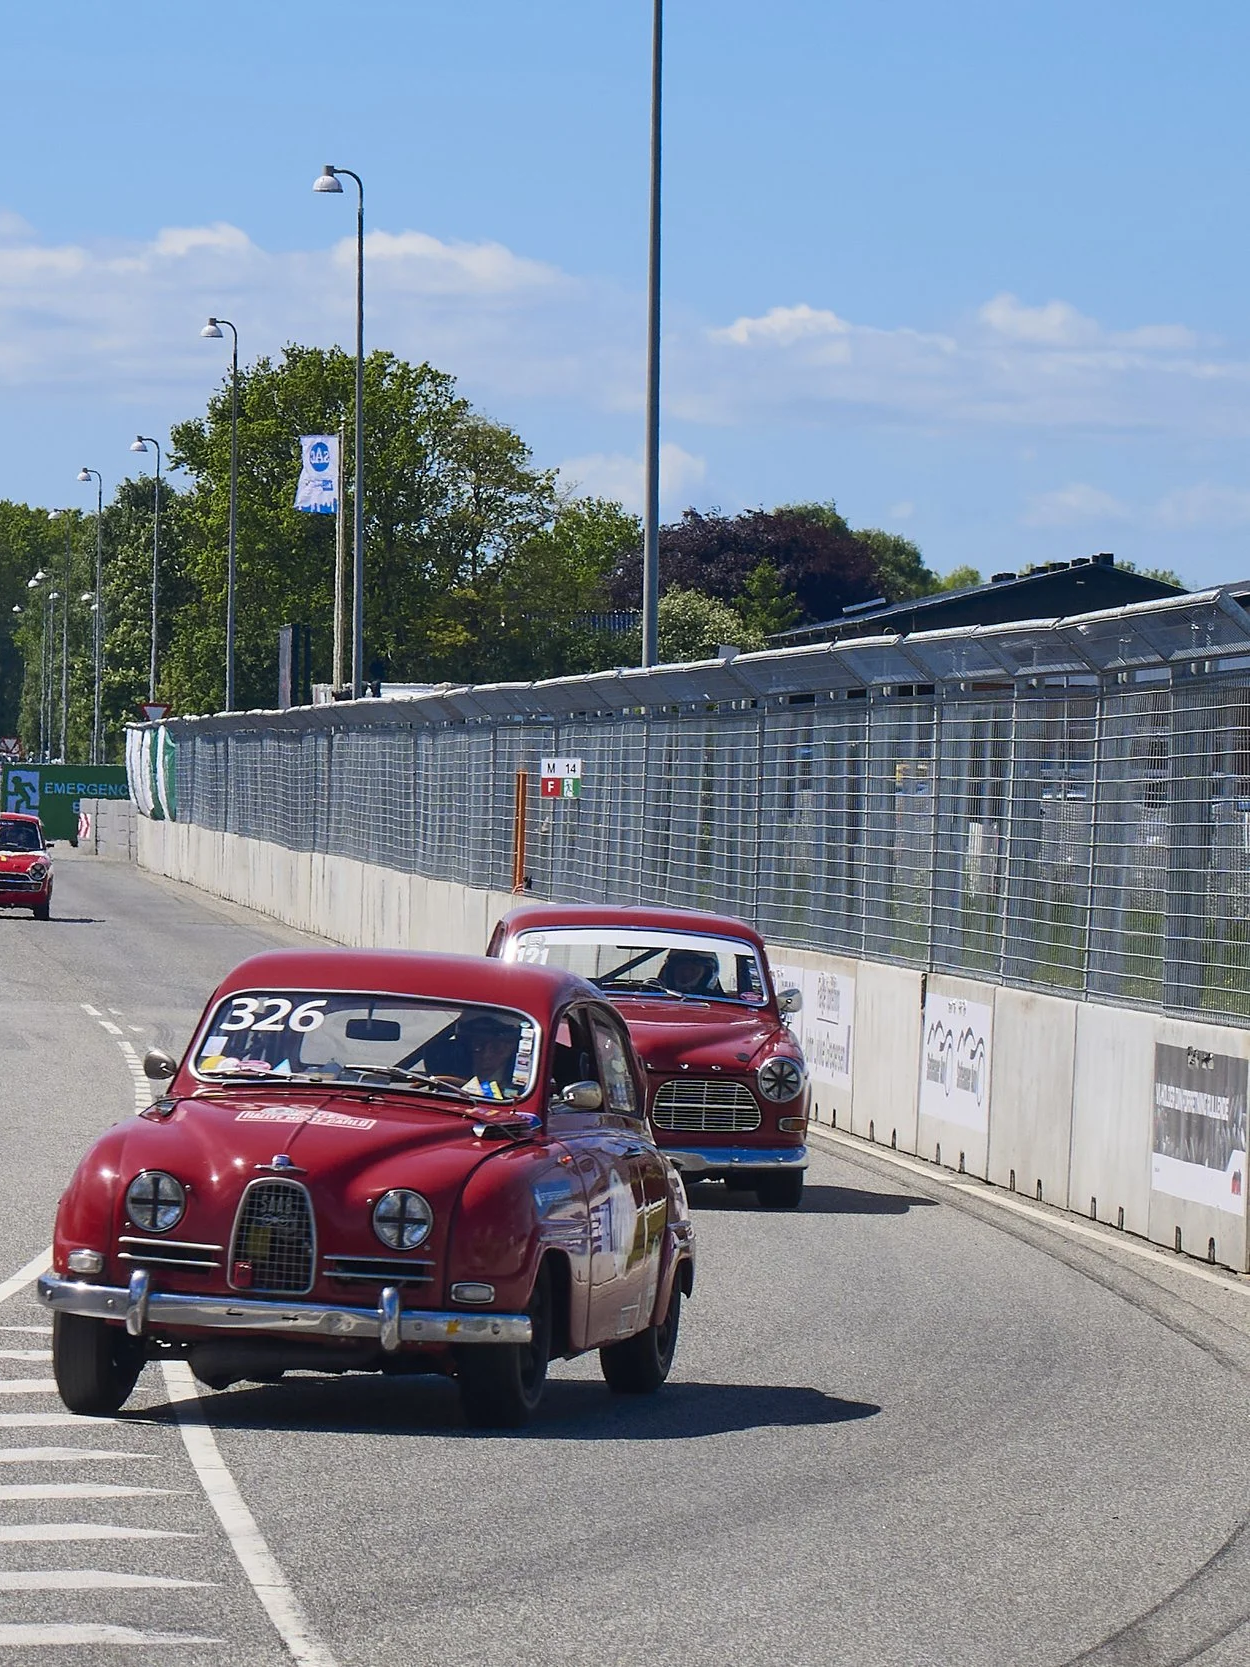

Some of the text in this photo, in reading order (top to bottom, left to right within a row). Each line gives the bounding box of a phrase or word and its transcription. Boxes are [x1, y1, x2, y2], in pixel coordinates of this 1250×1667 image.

[547, 763, 576, 774] M 14
[44, 782, 129, 796] EMERGENC
[547, 781, 555, 793] F
[219, 997, 328, 1033] 326
[259, 1195, 294, 1215] SAAB
